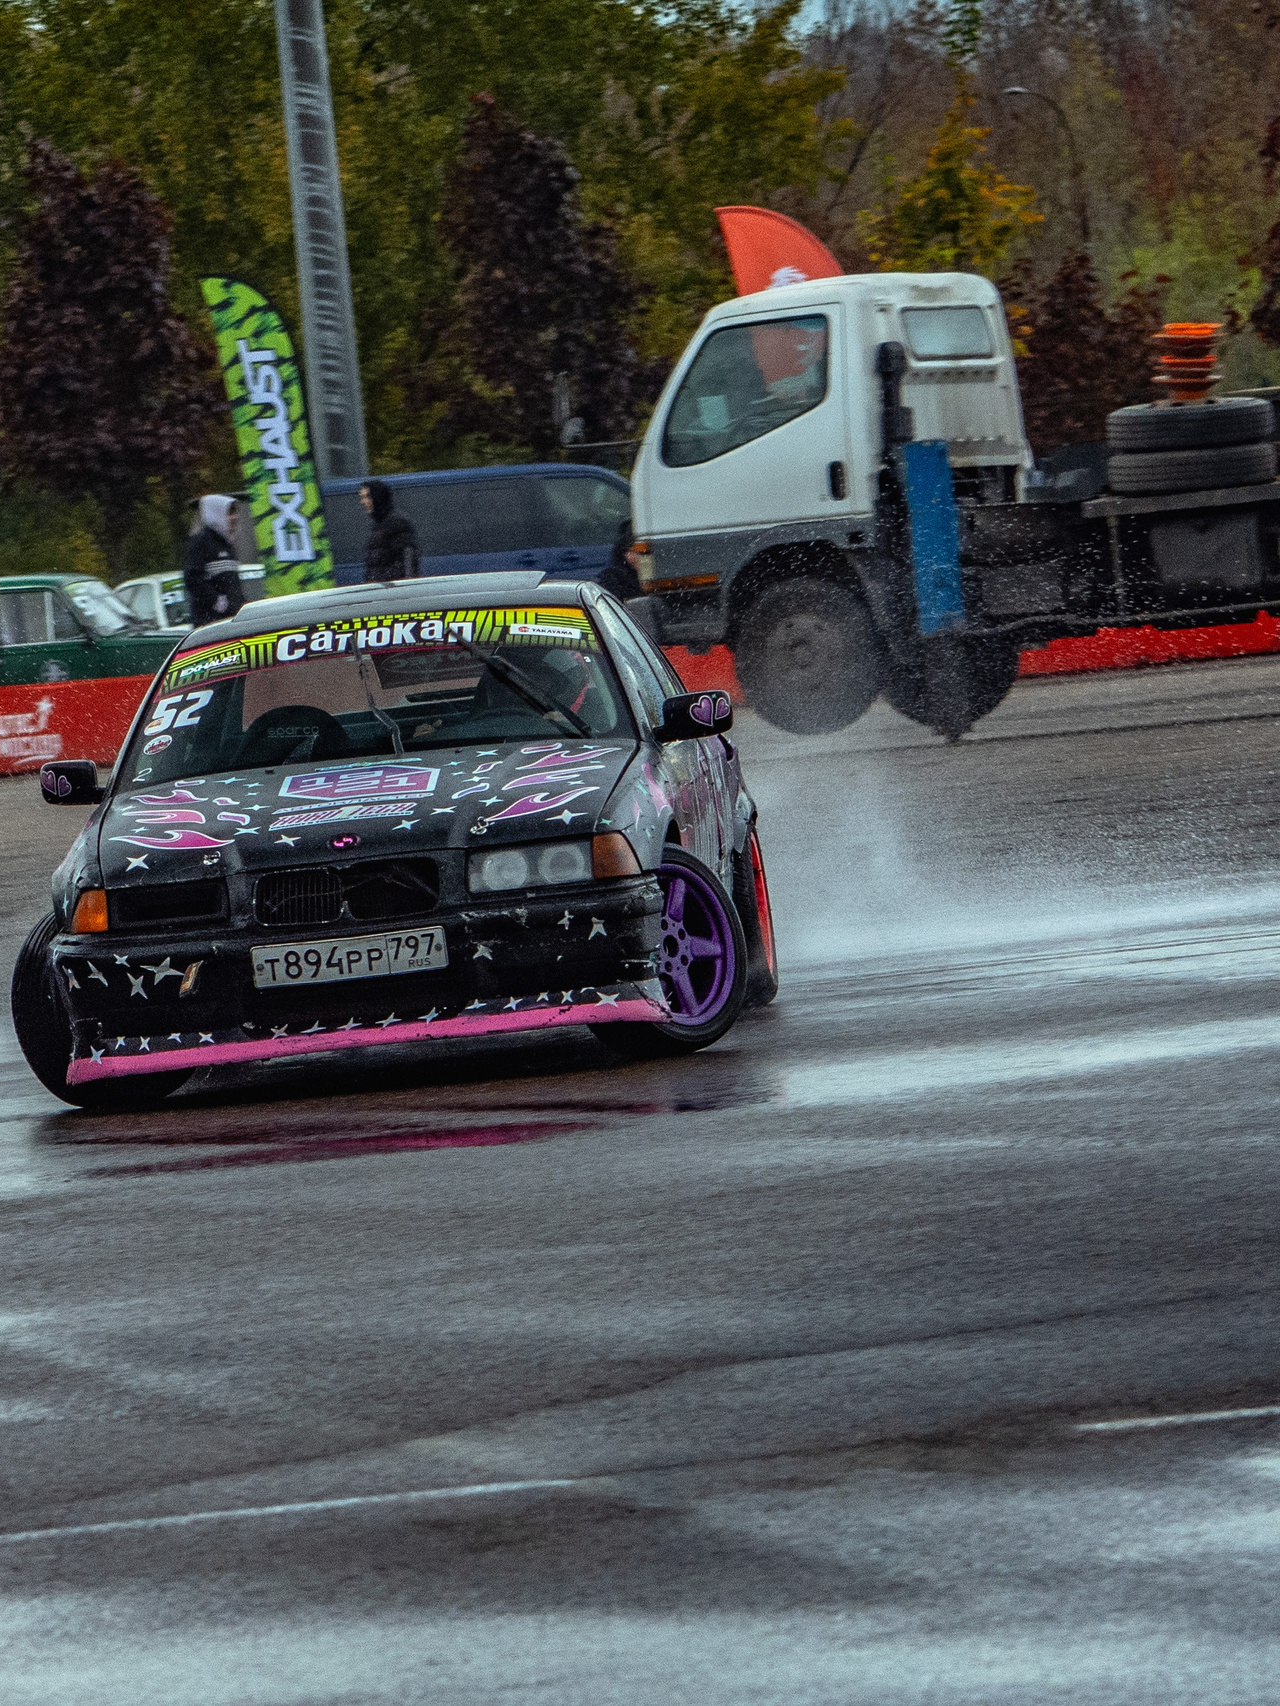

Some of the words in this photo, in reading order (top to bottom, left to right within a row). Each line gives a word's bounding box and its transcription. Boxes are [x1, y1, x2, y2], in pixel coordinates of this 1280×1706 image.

[236, 338, 316, 562] EXHAUST
[531, 627, 575, 637] TAKAYAMA
[179, 653, 241, 679] EXHAUST
[149, 689, 214, 734] 52
[132, 767, 153, 782] 2
[389, 933, 435, 961] 797
[407, 957, 432, 969] RUS
